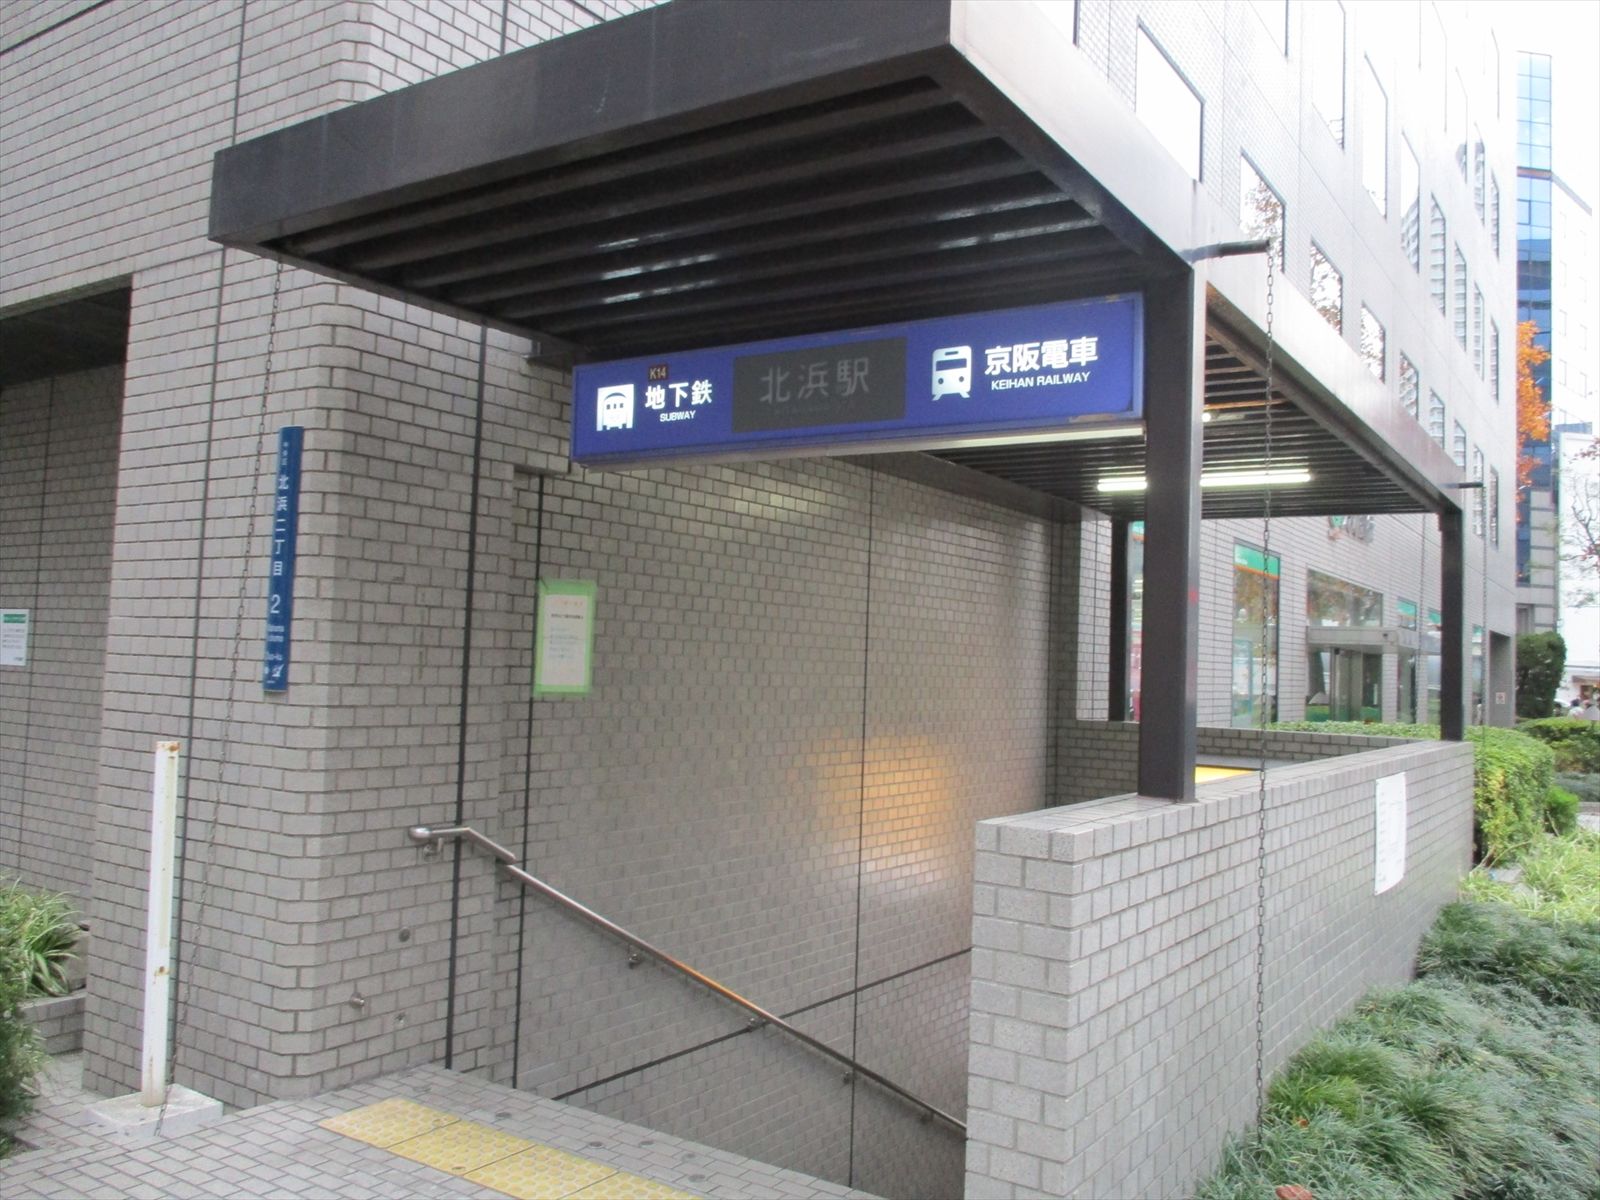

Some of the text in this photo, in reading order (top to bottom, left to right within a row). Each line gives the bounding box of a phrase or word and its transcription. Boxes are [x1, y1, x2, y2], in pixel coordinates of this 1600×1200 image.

[984, 336, 1099, 376] 京阪電車
[649, 366, 667, 380] K14
[759, 356, 870, 404] 北浜駅
[991, 371, 1092, 391] KEIHAN RAILWAY
[645, 379, 713, 410] 地下鉄
[659, 410, 697, 423] SUBWAY
[272, 474, 289, 577] 北浜二丁目
[270, 593, 281, 614] 2
